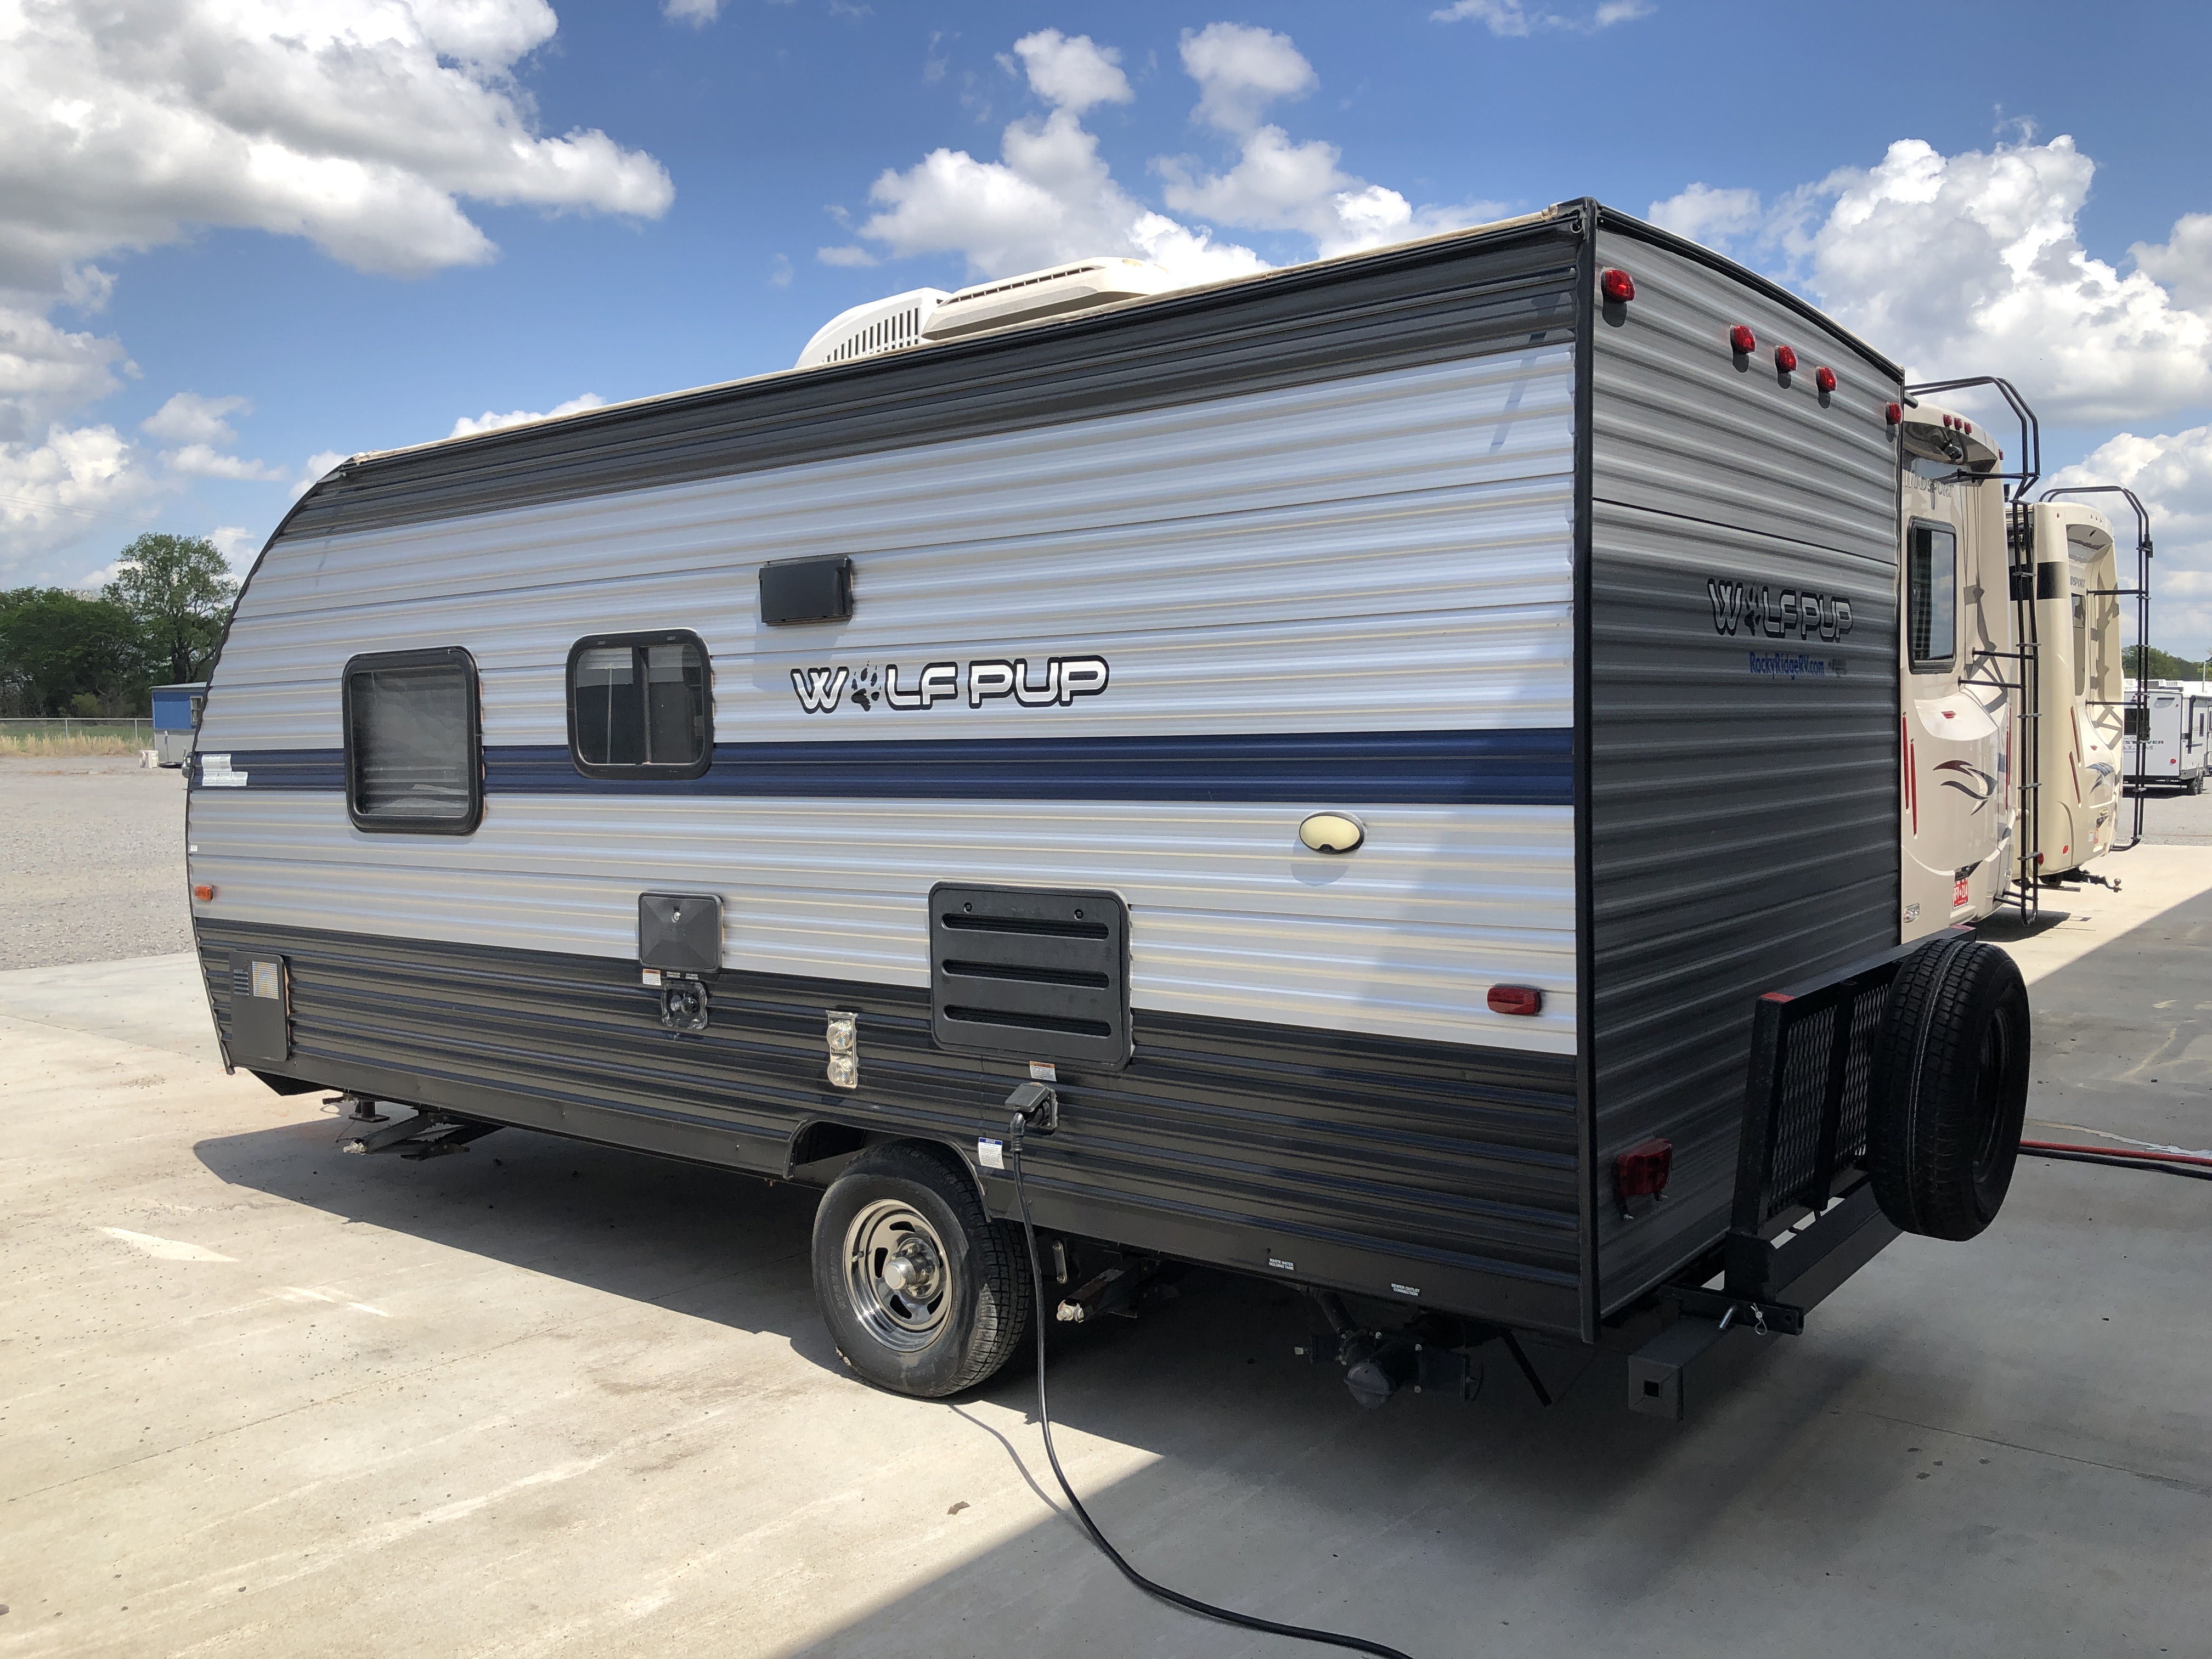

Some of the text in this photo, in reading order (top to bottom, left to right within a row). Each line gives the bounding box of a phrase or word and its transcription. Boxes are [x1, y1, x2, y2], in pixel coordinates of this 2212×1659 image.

[1905, 470, 1954, 498] WINDSPORT
[1707, 578, 1853, 643] WLF PUP
[1749, 651, 1825, 680] RockyRidgeRV.com
[791, 654, 1110, 714] WLF PUP
[1393, 1287, 1418, 1296] CONNECTION
